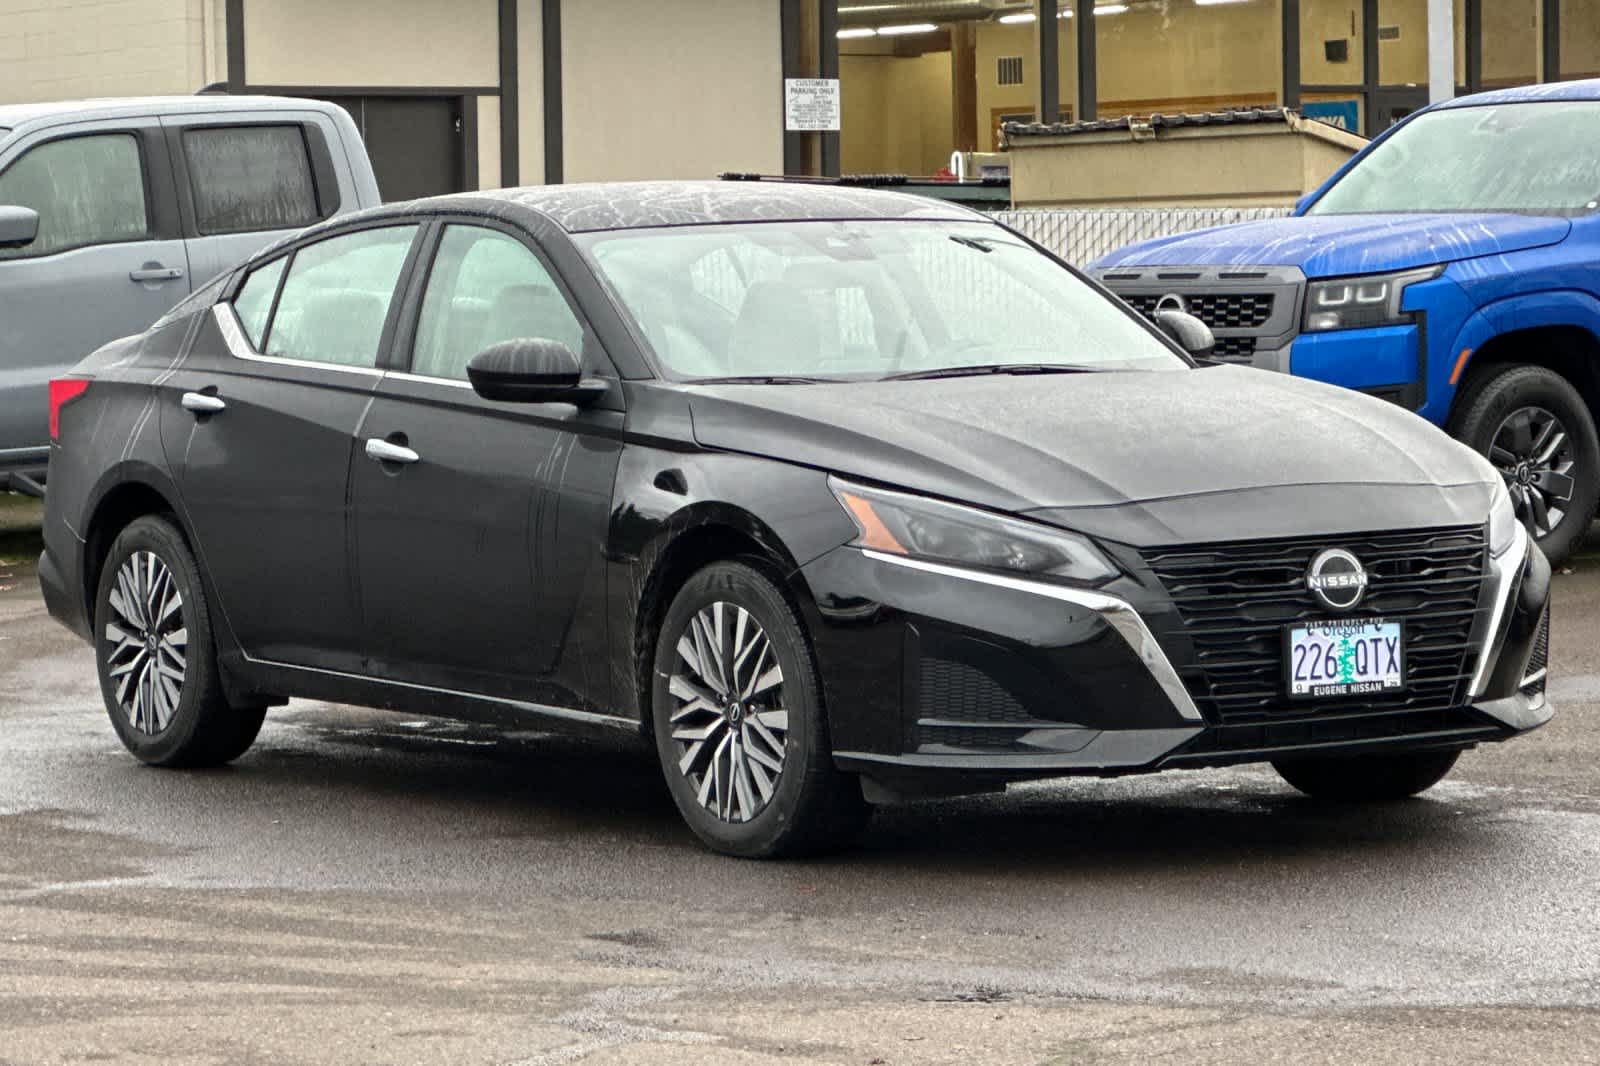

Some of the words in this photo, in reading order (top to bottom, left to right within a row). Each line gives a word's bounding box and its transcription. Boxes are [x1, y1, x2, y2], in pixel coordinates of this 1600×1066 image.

[795, 79, 829, 87] CUSTOMER
[790, 87, 817, 95] PARKING
[819, 87, 835, 95] ONLY
[1307, 573, 1368, 589] NISSAN
[1323, 624, 1365, 638] Oregon
[1294, 642, 1338, 681] 226
[1355, 636, 1399, 676] QTX
[1313, 685, 1347, 697] EUGENE
[1350, 682, 1382, 694] NISSAN
